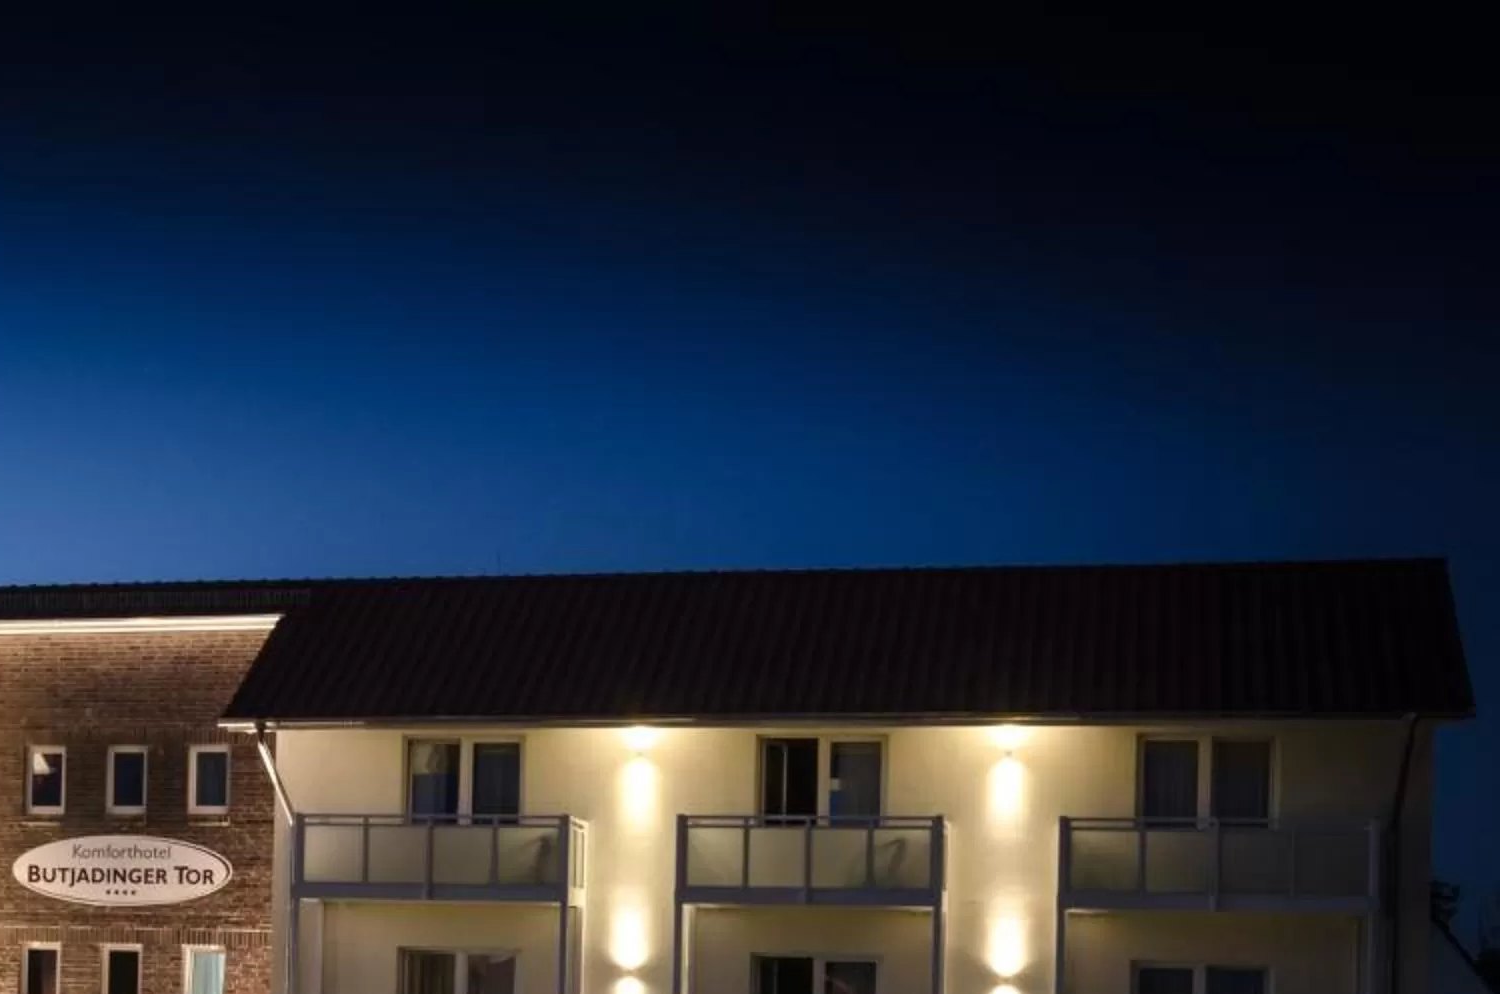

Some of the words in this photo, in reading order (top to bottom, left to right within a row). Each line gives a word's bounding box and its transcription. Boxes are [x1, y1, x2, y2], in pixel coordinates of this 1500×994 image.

[72, 844, 171, 859] Komforthotel
[27, 865, 167, 887] BUTJADINGER
[174, 866, 214, 884] TOR
